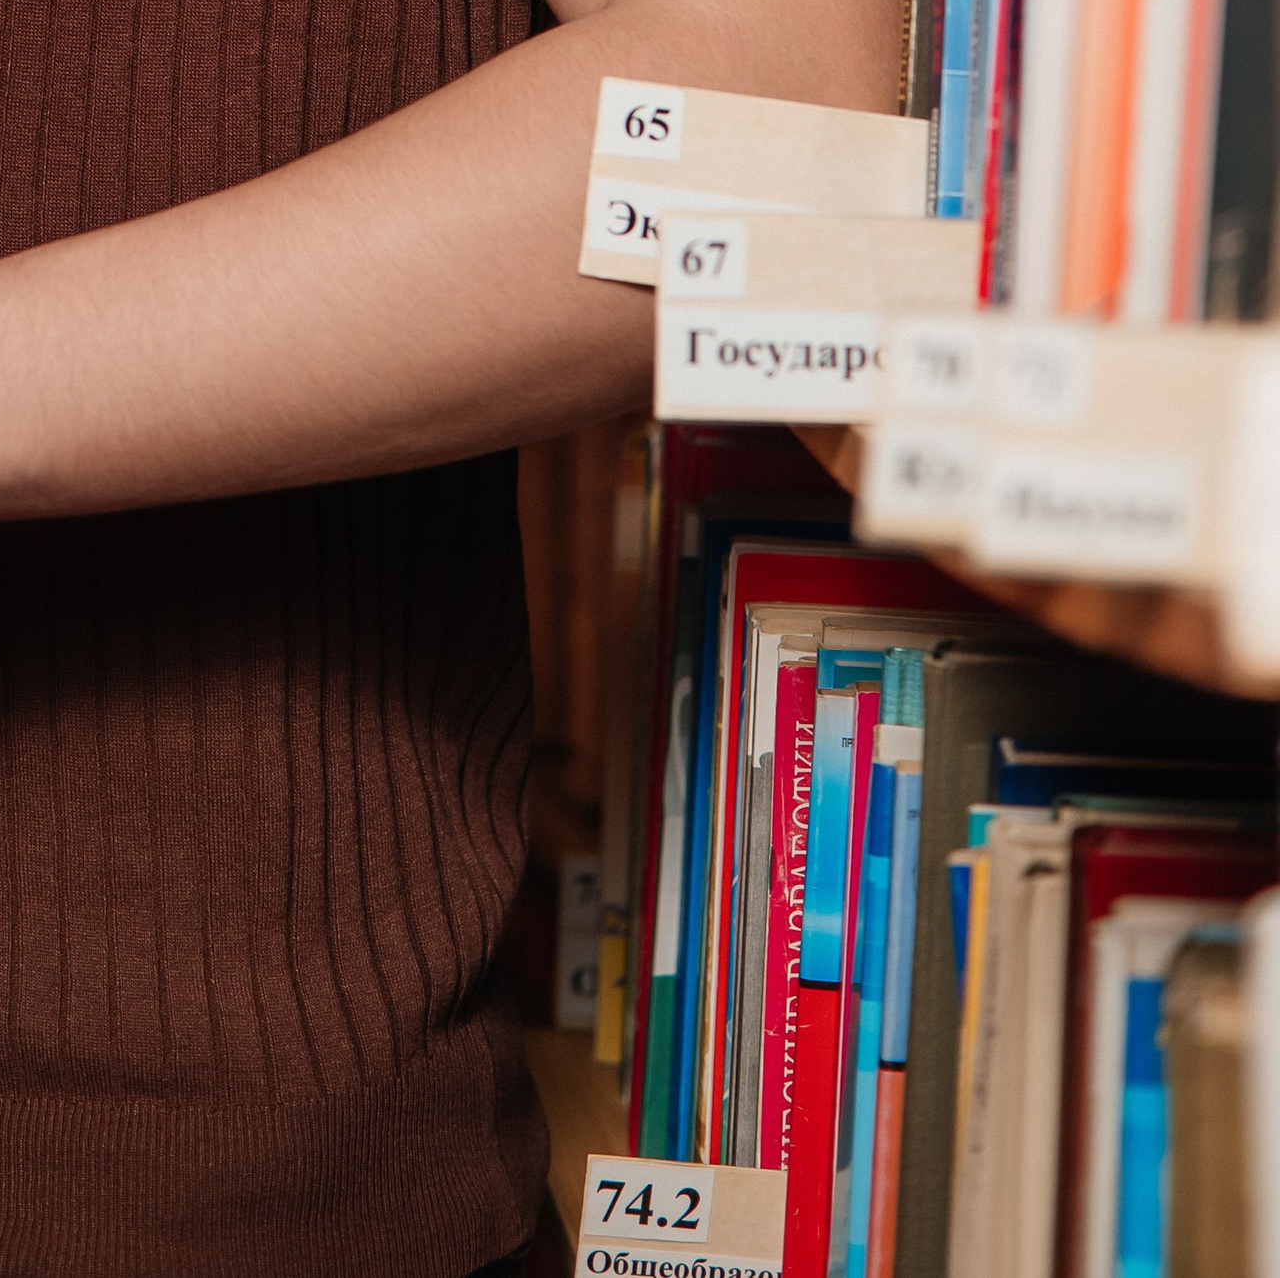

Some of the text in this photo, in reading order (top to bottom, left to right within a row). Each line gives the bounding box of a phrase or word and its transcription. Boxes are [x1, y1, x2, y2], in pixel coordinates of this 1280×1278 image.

[624, 103, 671, 142] 65
[681, 237, 728, 277] 67
[596, 1179, 701, 1230] 74.2
